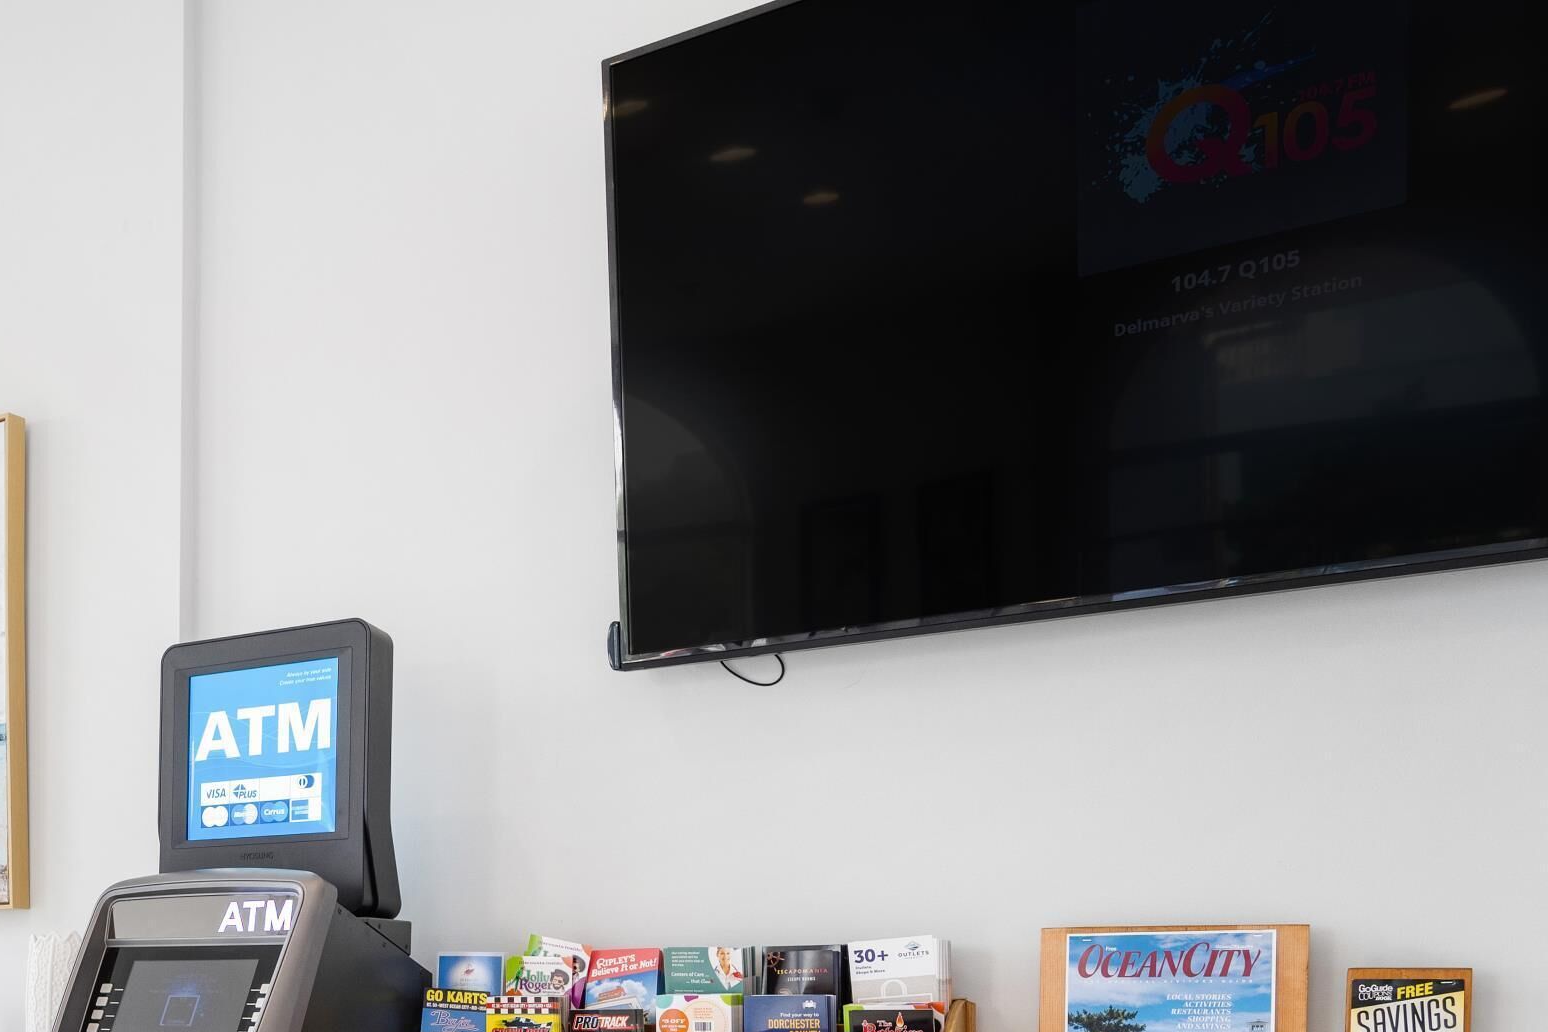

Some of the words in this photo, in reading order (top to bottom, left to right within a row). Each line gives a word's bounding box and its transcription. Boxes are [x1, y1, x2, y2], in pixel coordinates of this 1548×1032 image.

[1171, 266, 1231, 293] 104.7
[1238, 249, 1301, 280] Q105
[1114, 304, 1214, 338] Delmarva's
[1219, 289, 1287, 317] Variety
[1290, 274, 1364, 302] Station
[194, 698, 332, 762] ATM
[206, 787, 227, 799] VISA
[238, 788, 258, 799] PLUS
[263, 807, 286, 817] Cirrus
[217, 899, 294, 933] ATM
[596, 953, 636, 970] RIPLEY'S
[853, 949, 889, 964] 30+
[897, 950, 930, 958] OUTLETS
[519, 979, 552, 994] Roger
[1358, 984, 1393, 993] GoGuide
[1396, 982, 1434, 999] FREE
[426, 989, 444, 1002] GO
[446, 991, 488, 1005] KARTS
[1170, 1008, 1232, 1016] RESTAURANTS
[768, 1018, 821, 1029] DORCHESTER
